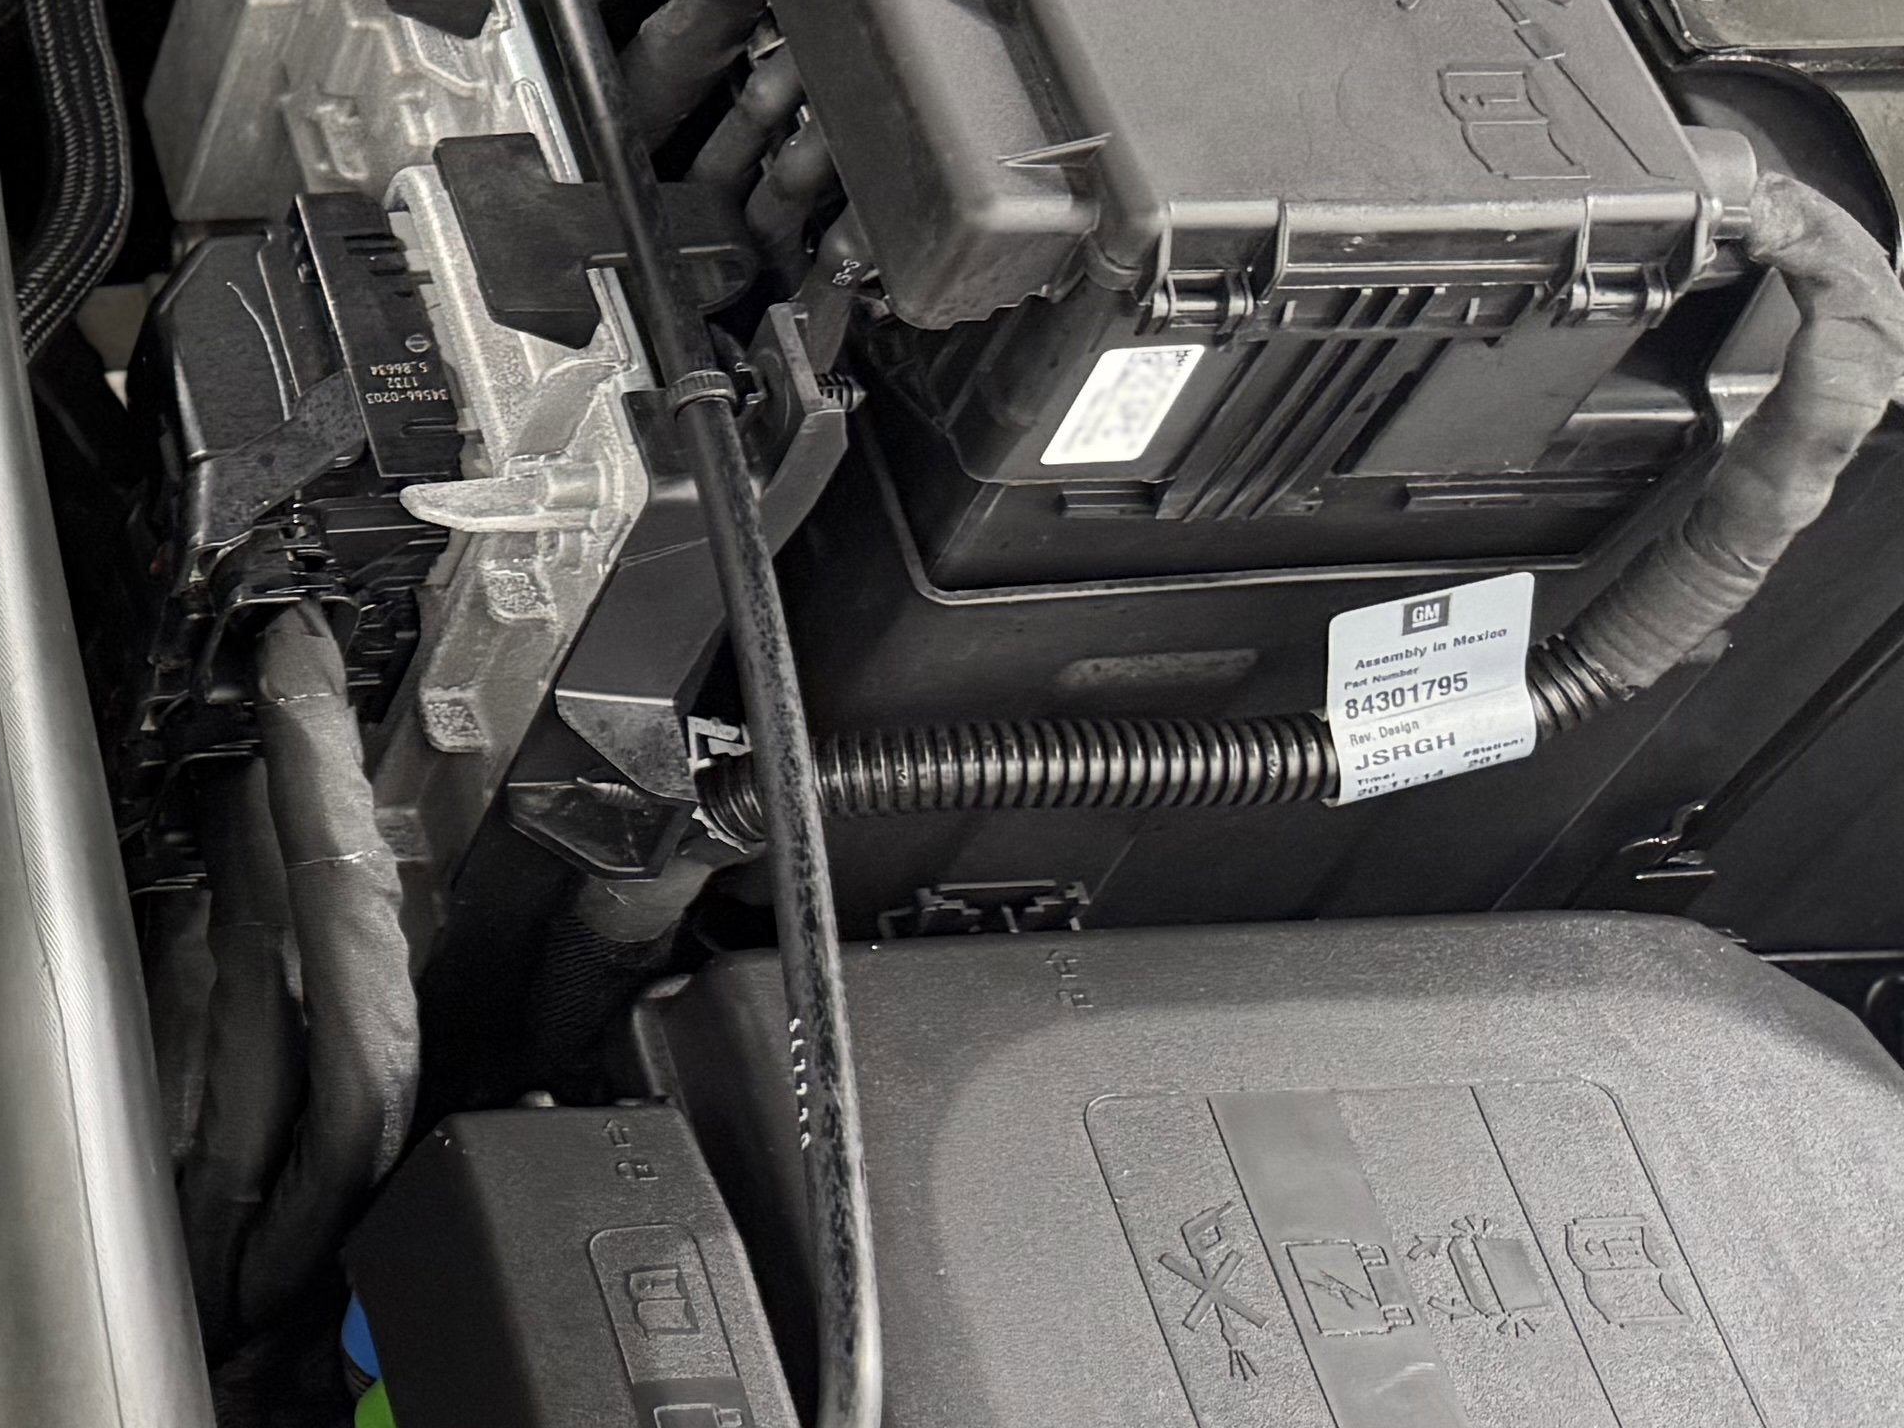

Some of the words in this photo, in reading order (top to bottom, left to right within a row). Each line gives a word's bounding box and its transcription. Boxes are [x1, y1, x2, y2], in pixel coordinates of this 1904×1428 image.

[1411, 602, 1441, 623] GM
[1354, 645, 1428, 671] Assembly
[1432, 641, 1447, 653] in
[1452, 627, 1508, 648] Mexico
[1343, 679, 1368, 691] Part
[1372, 666, 1420, 684] Number
[1344, 671, 1469, 720] 84301795
[1349, 732, 1377, 748] Rev.
[1378, 720, 1420, 740] Design
[1354, 731, 1457, 772] JSRGH
